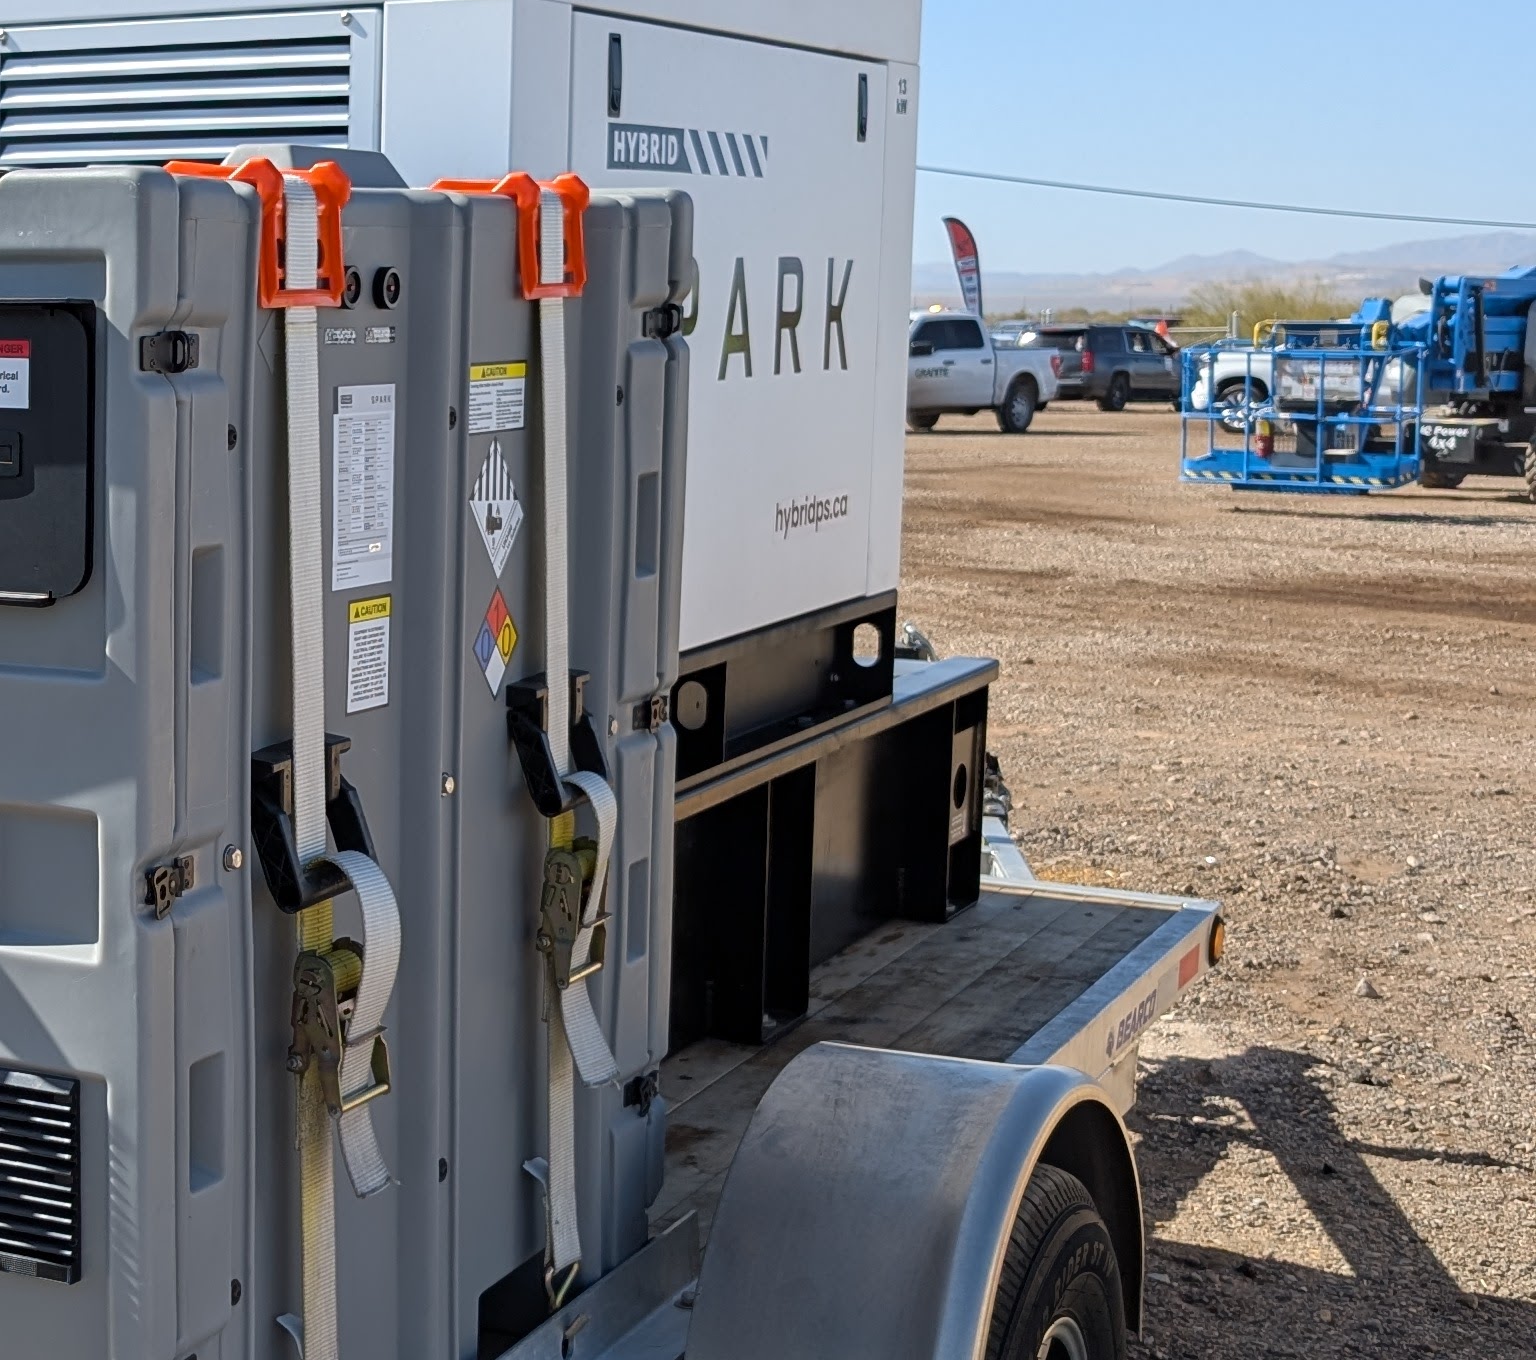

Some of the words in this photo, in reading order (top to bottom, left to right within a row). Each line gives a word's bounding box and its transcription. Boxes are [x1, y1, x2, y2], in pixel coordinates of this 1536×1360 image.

[613, 130, 678, 166] HYBRID
[1433, 425, 1470, 438] Power
[774, 494, 848, 540] hybridps.ca
[360, 602, 387, 617] CAUTION
[501, 622, 512, 658] 0
[1115, 988, 1157, 1050] BEARCO
